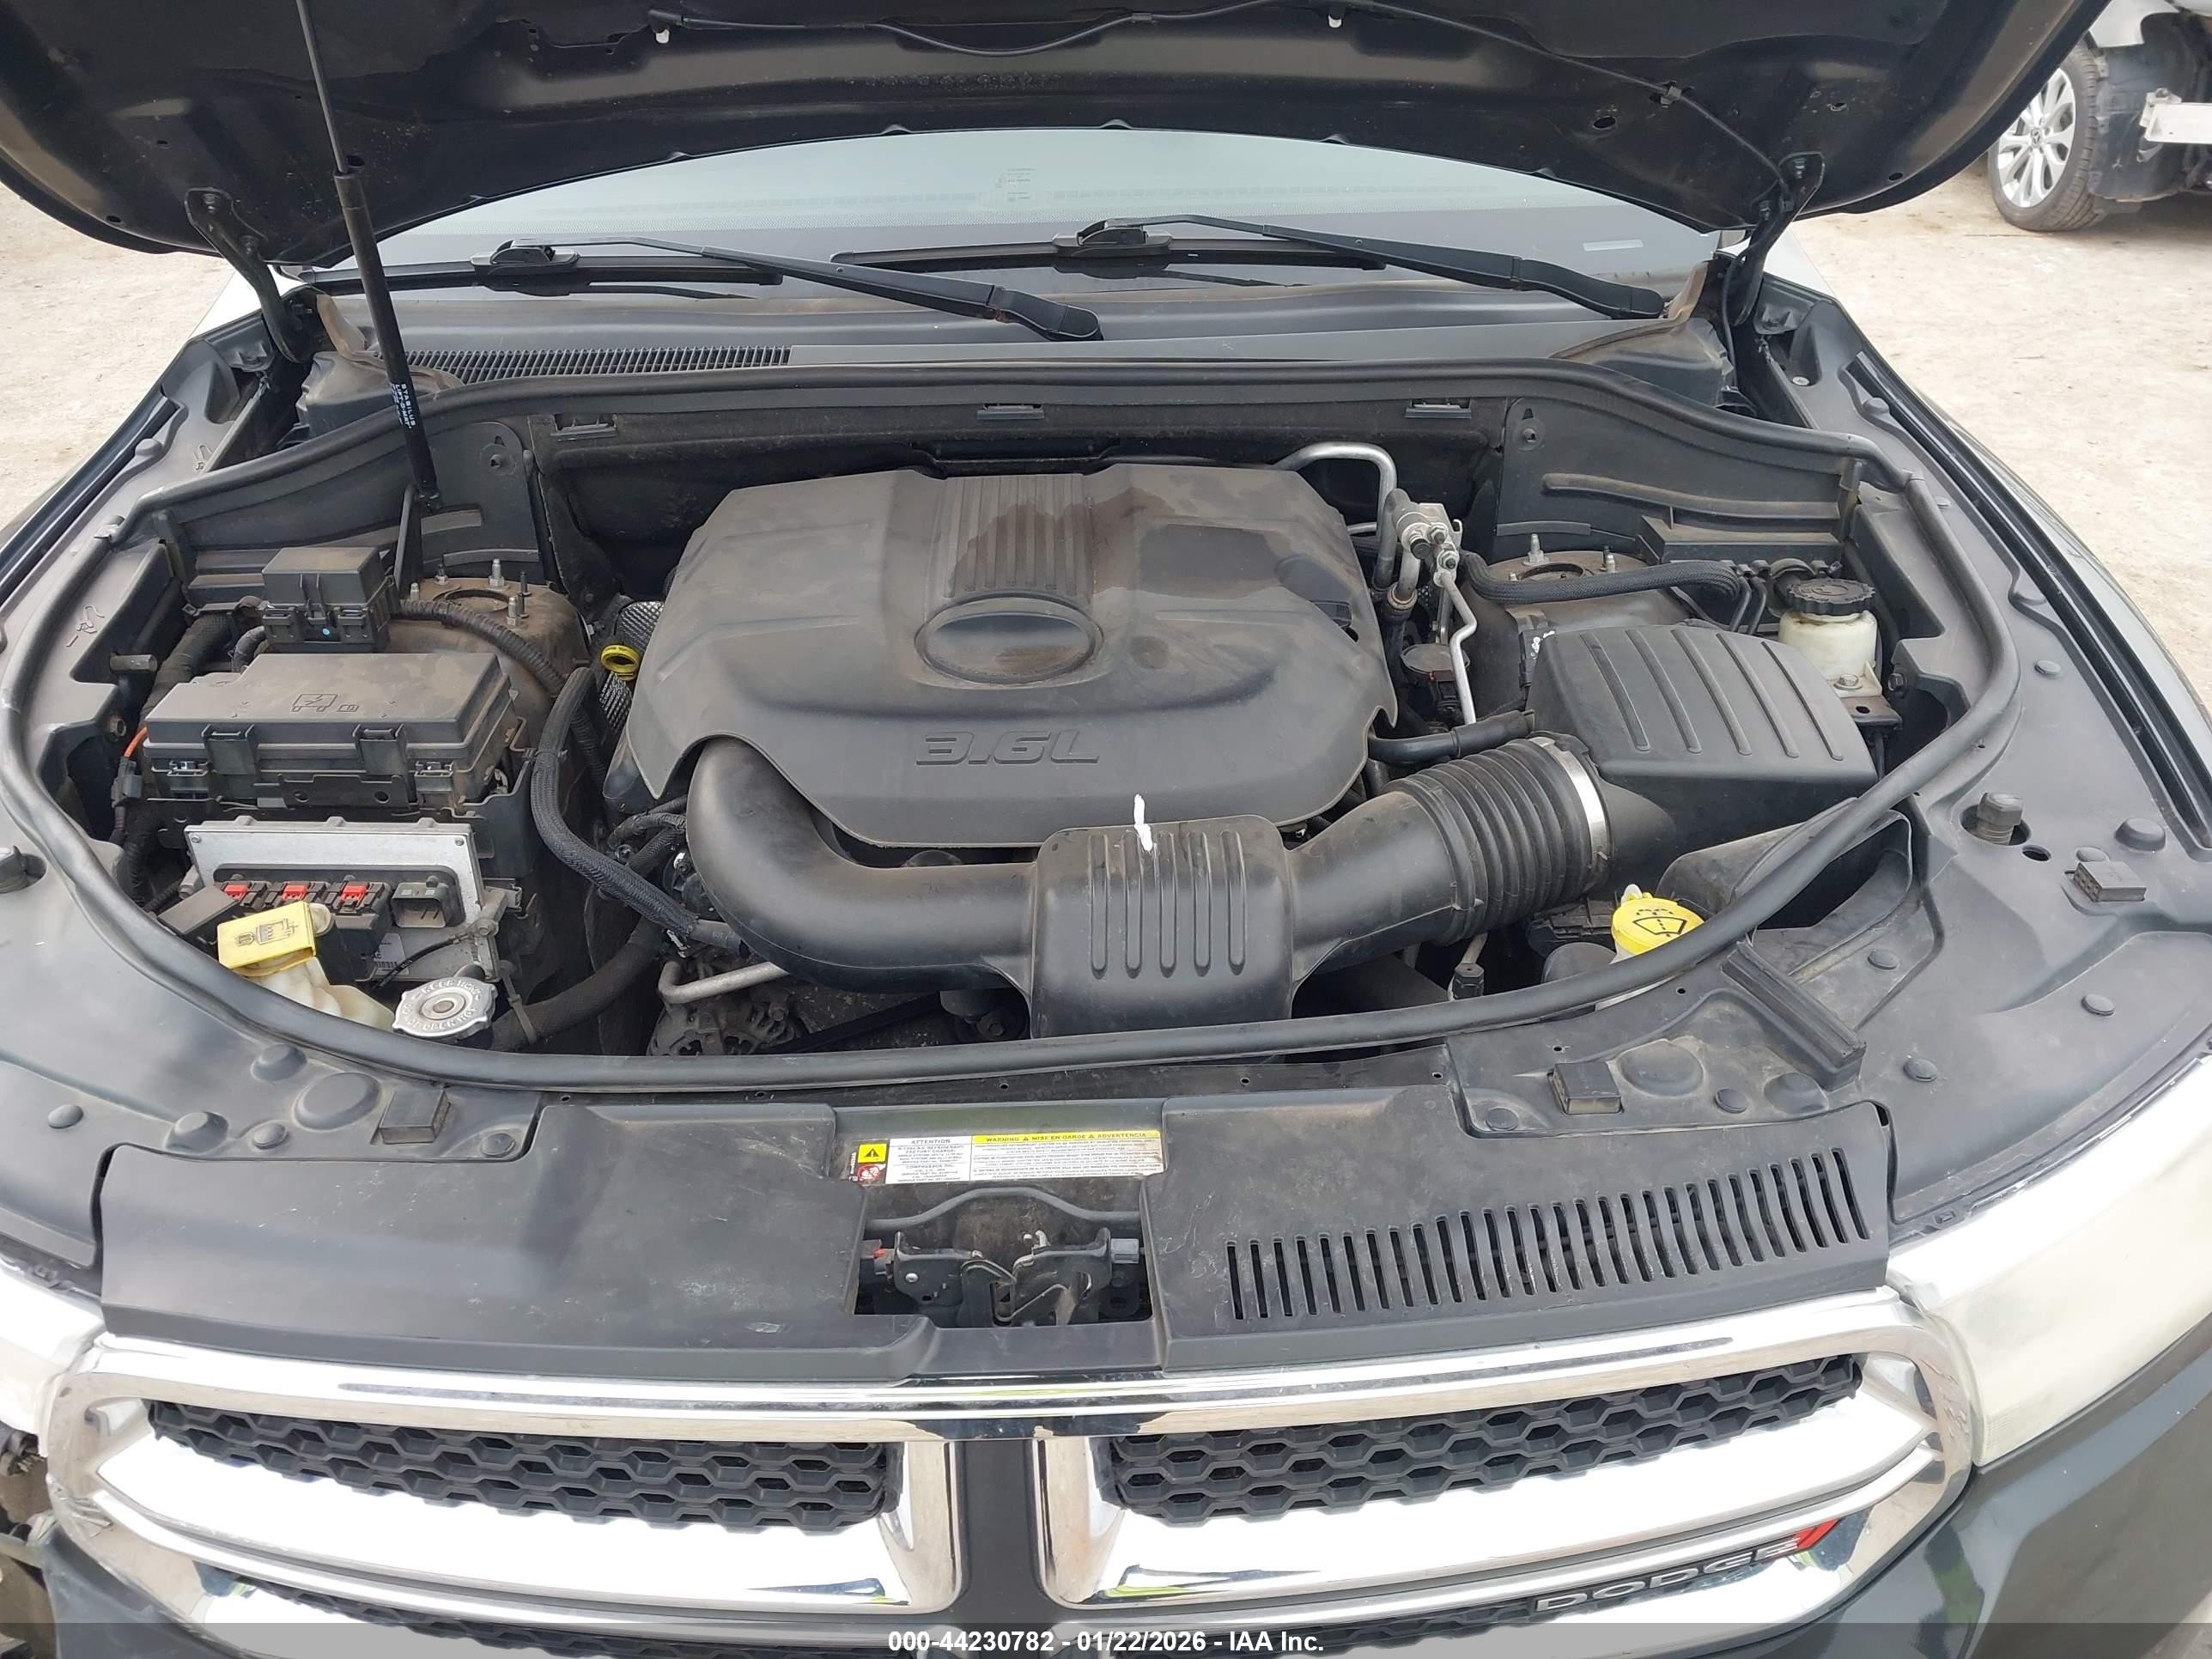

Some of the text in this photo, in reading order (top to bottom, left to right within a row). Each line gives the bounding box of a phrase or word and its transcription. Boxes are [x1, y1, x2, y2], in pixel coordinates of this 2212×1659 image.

[401, 384, 416, 426] STABILUS
[915, 731, 1100, 765] 3.6L
[1536, 1534, 1801, 1612] DODGE
